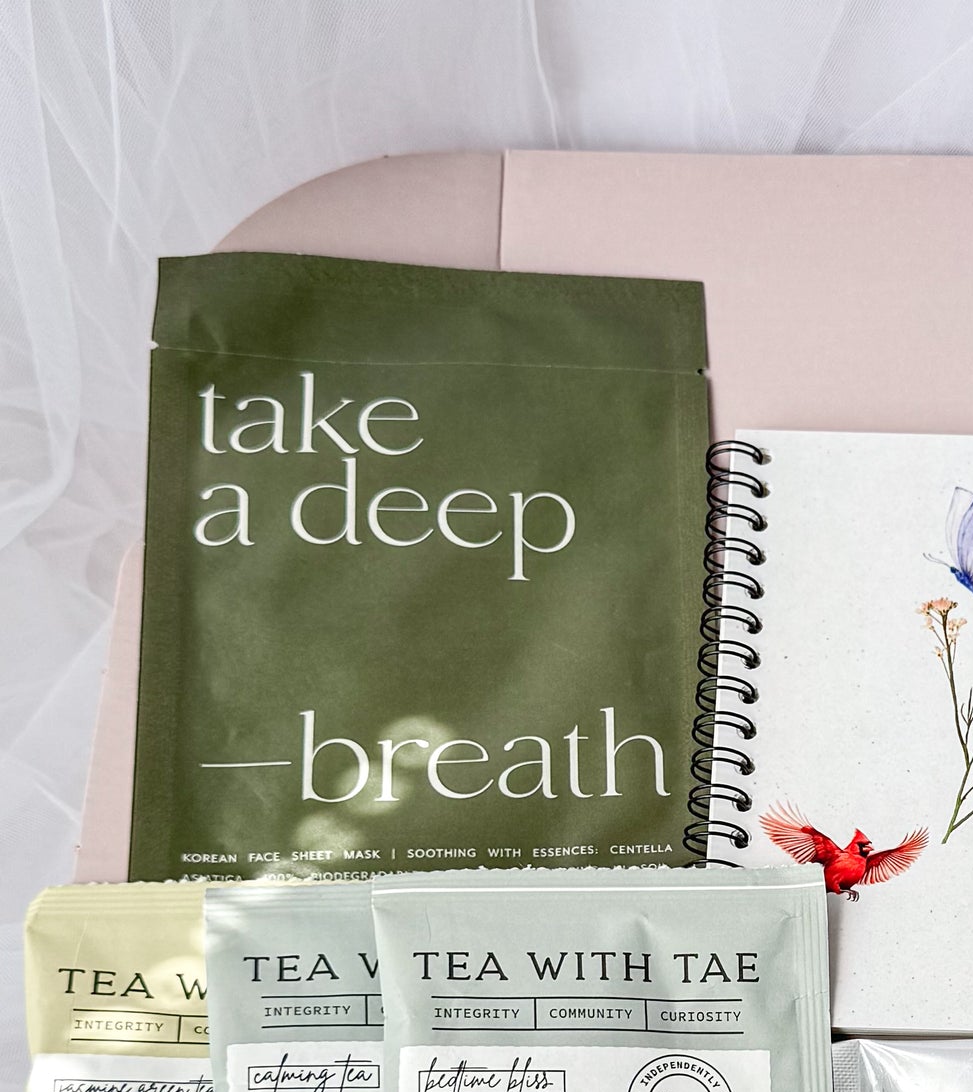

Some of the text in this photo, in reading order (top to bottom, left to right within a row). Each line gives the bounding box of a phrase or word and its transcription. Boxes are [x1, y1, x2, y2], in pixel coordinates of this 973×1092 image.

[198, 371, 424, 456] take
[194, 457, 577, 582] a deep
[182, 853, 238, 863] KOREAN
[248, 852, 281, 862] FACE
[291, 850, 333, 861] SHEET
[343, 850, 381, 860] MASK
[407, 848, 477, 859] SOOTHING
[487, 848, 522, 858] WITH
[532, 845, 599, 857] ESSENCES:
[609, 844, 673, 855] CENTELLA
[243, 953, 340, 983] TEA
[413, 952, 760, 984] TEA WITH TAE
[58, 968, 155, 999] TEA
[264, 1005, 352, 1017] INTEGRITY
[434, 1007, 520, 1019] INTEGRITY
[549, 1007, 633, 1020] COMMUNITY
[660, 1010, 742, 1023] CURIOSITY
[74, 1019, 164, 1032] INTEGRITY
[640, 1061, 721, 1088] INDEPENDENTLY
